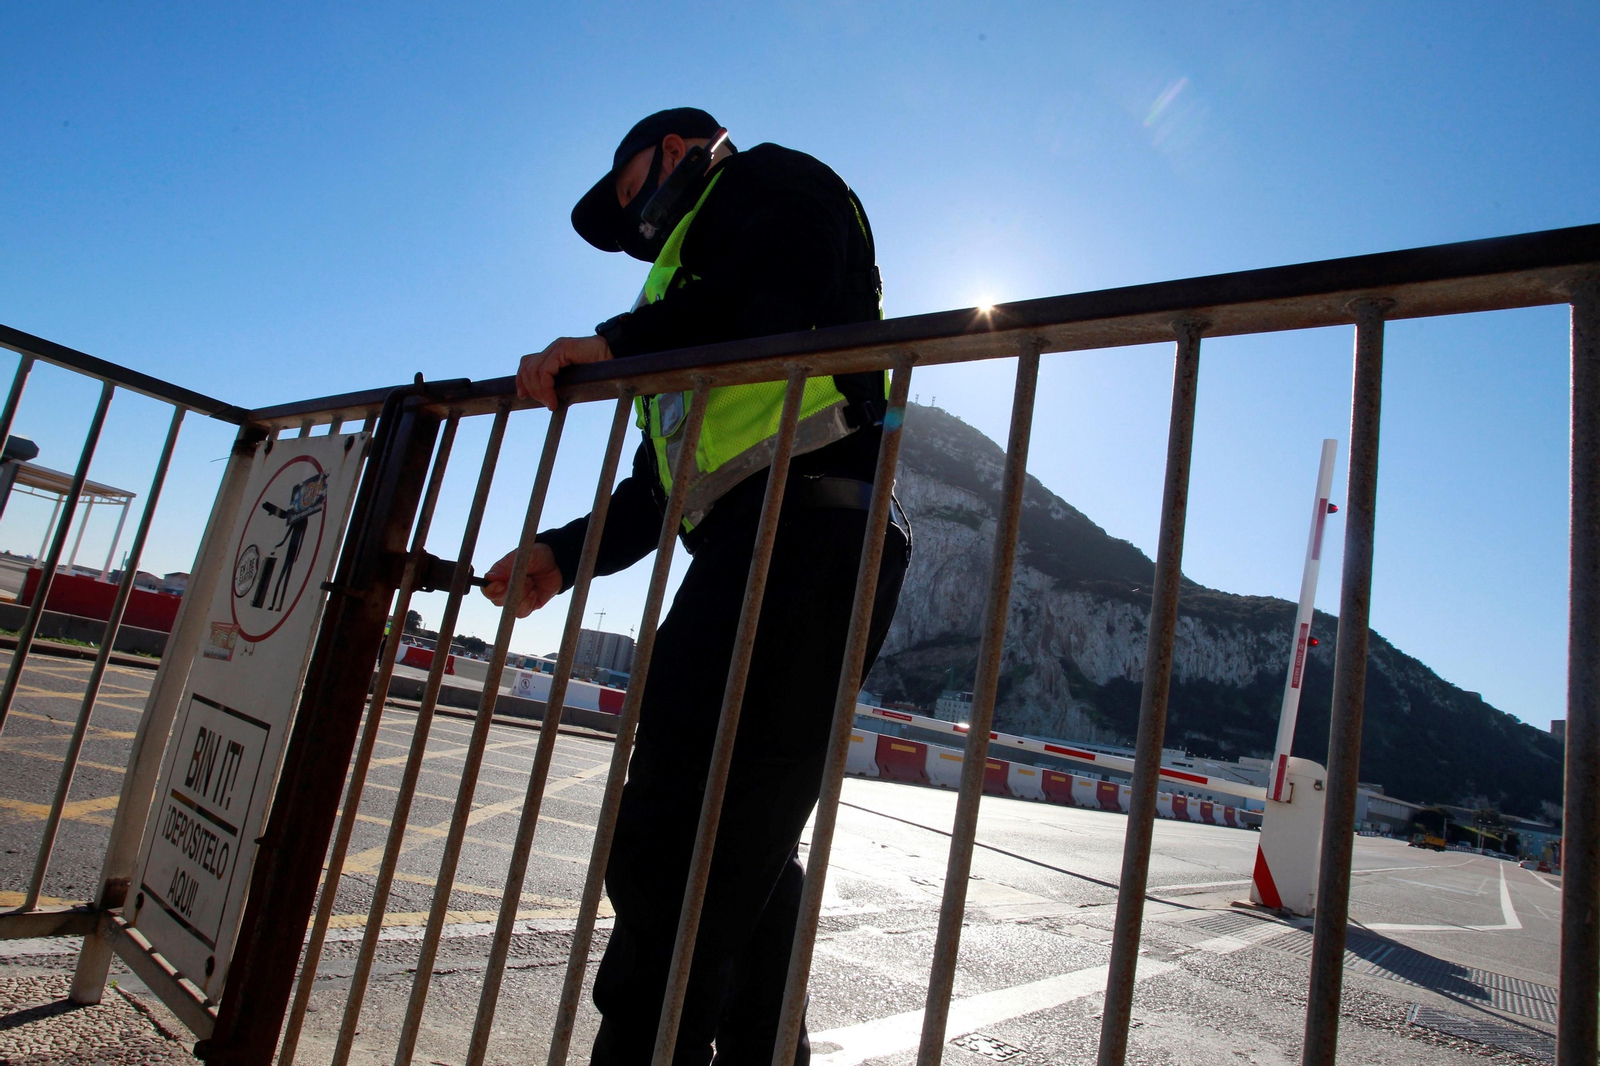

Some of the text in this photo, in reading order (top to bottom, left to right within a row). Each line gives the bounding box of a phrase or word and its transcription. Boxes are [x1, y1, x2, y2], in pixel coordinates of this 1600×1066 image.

[185, 726, 245, 811] BIN IT!
[162, 804, 230, 881] ¡DEPOSITELO
[167, 866, 199, 918] AQUI!
